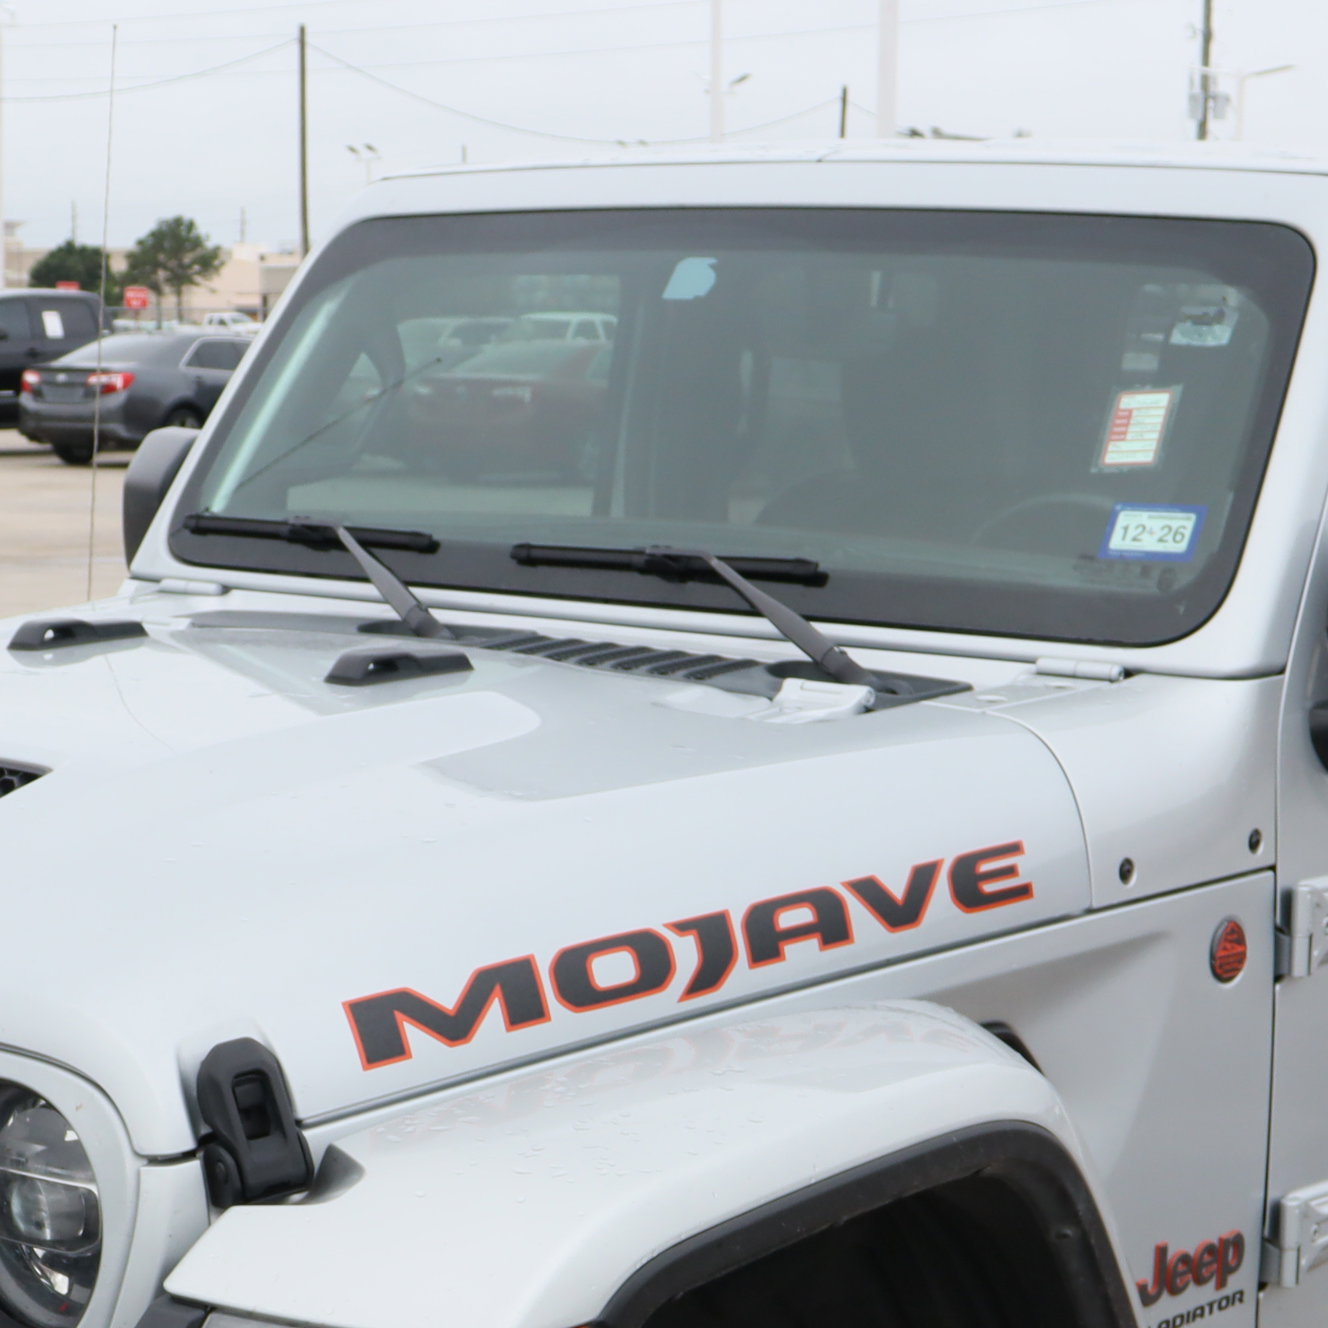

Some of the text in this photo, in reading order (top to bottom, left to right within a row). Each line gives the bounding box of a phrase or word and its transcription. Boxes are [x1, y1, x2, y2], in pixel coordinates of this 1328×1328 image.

[1119, 523, 1188, 544] 12 26
[341, 839, 1035, 1072] MOJAVE
[1136, 1229, 1245, 1308] Jeep
